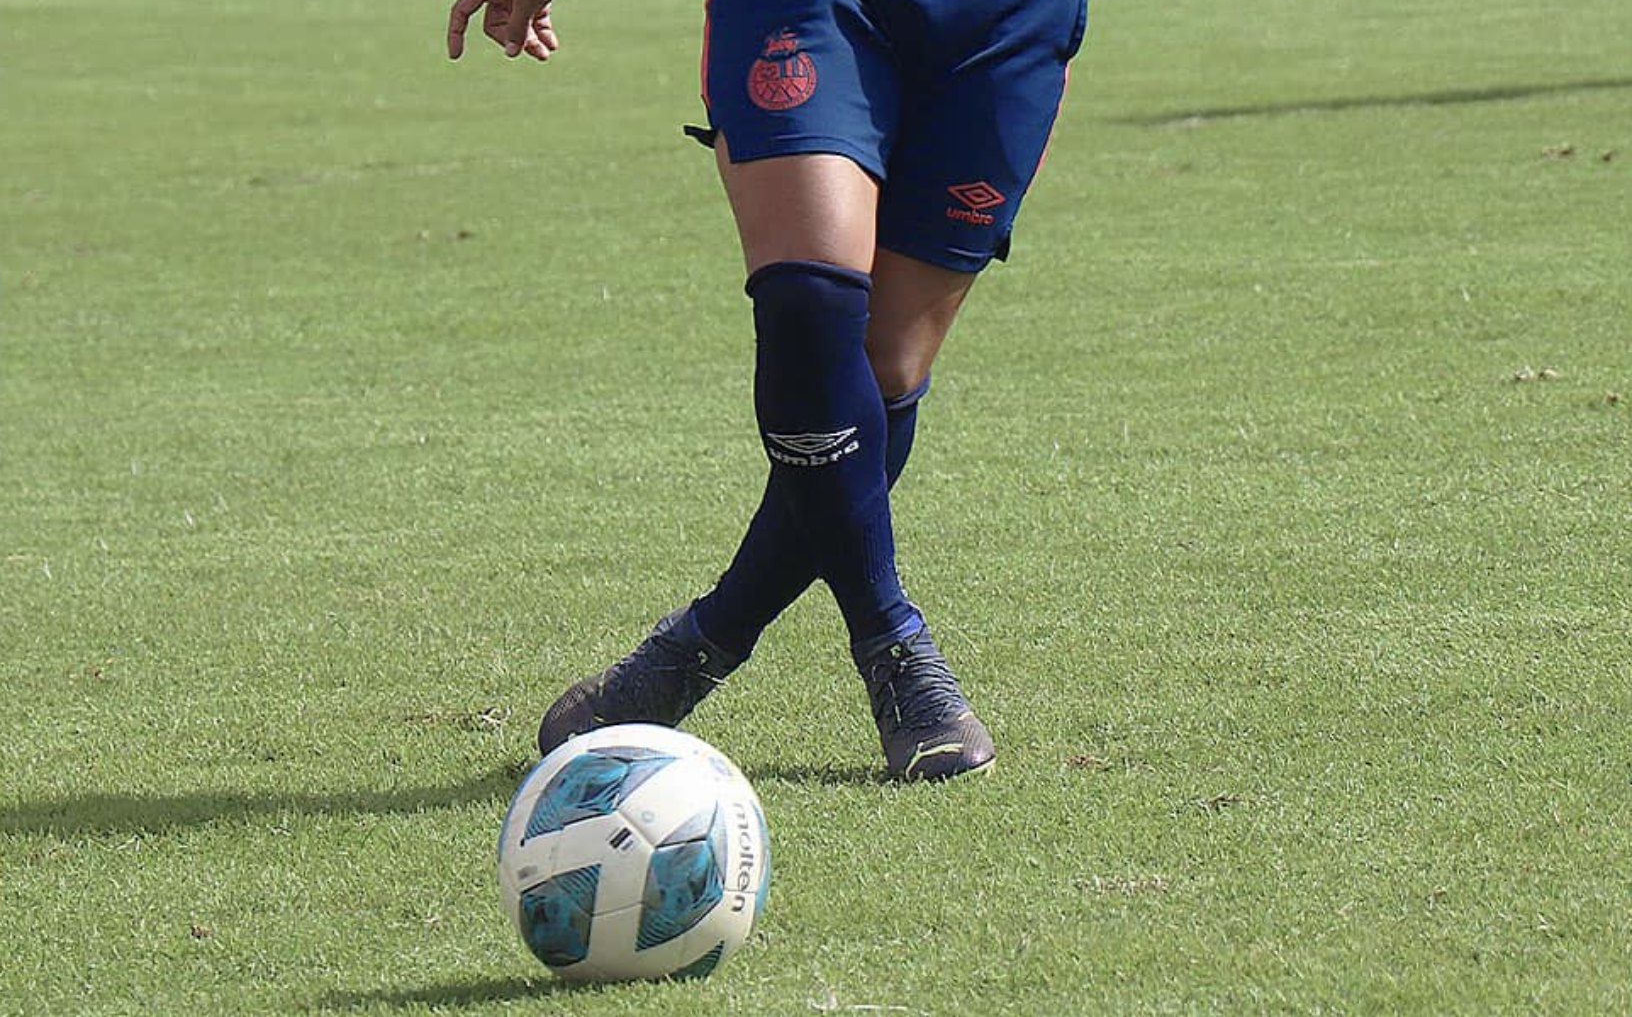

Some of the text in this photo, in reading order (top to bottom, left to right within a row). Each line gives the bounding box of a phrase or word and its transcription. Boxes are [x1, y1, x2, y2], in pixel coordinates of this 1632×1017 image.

[947, 207, 994, 224] umbro
[769, 440, 859, 466] umbro
[730, 801, 755, 913] molten
